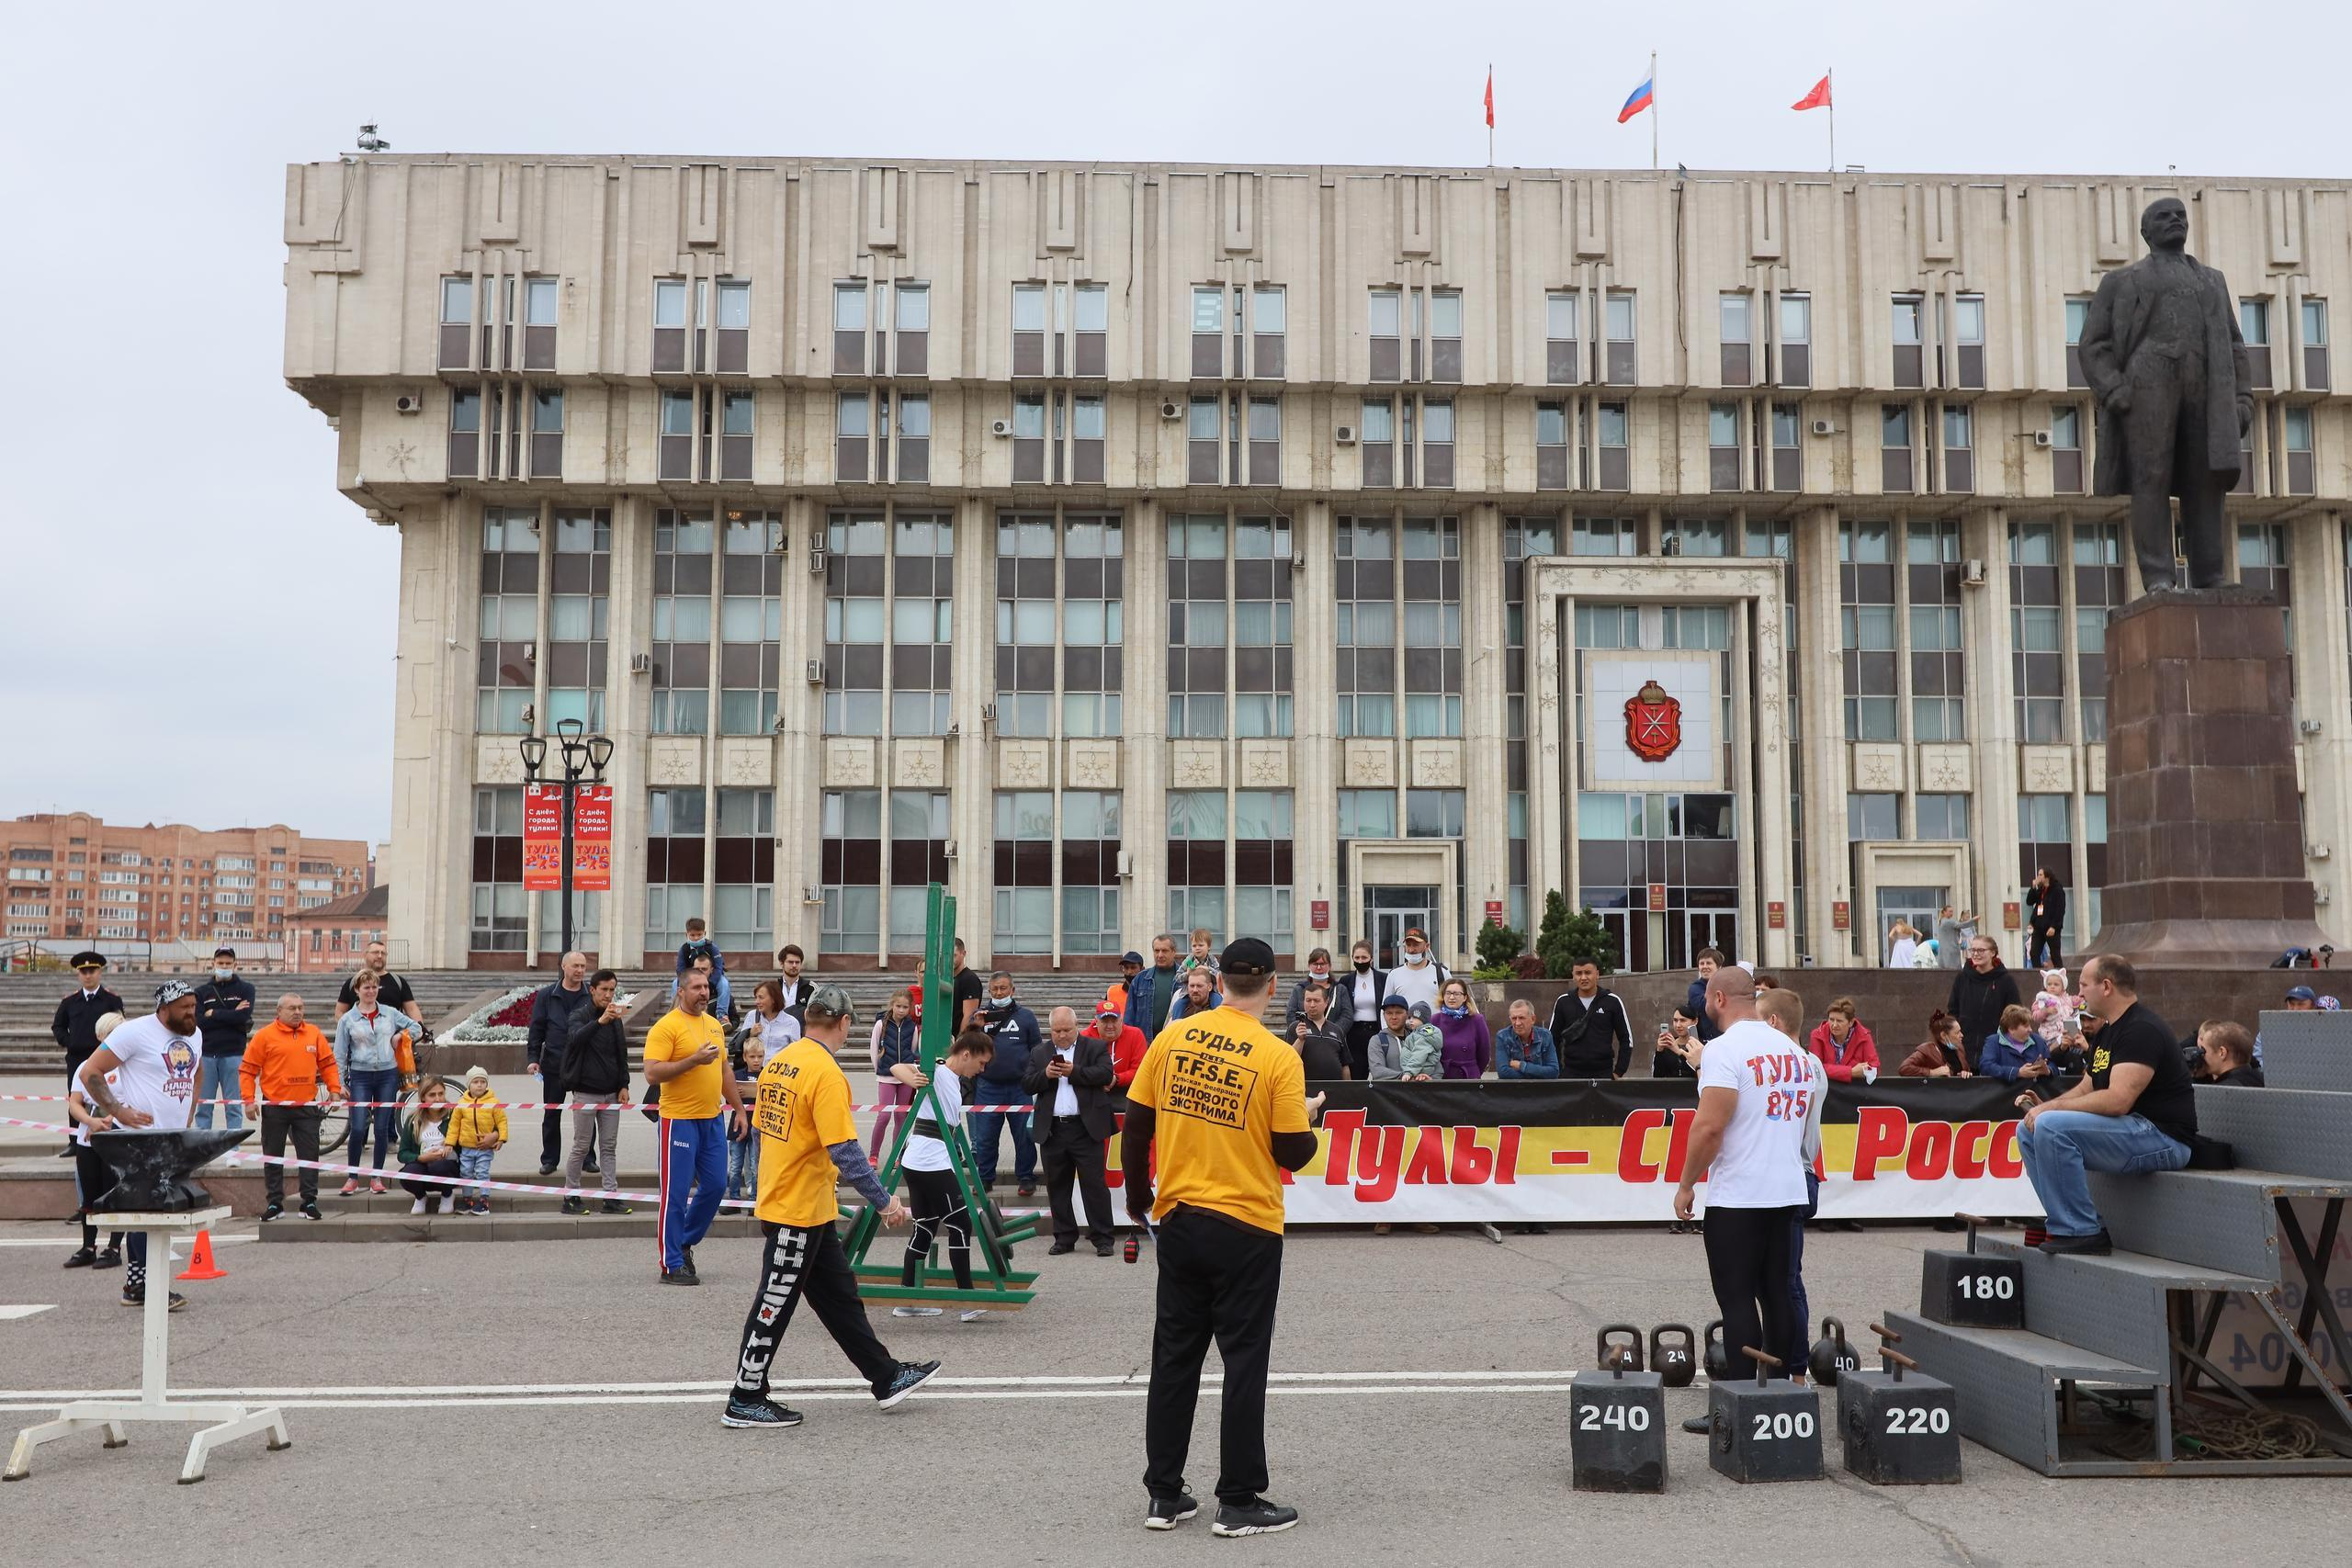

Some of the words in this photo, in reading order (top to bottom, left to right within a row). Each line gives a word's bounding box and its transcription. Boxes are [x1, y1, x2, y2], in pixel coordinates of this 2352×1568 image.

[1185, 1028, 1253, 1057] СУДЬЯ
[1175, 1055, 1243, 1090] T.F.S.E.
[1170, 1084, 1238, 1111] СИЛОВОГО
[1171, 1075, 1201, 1087] Тульская
[1203, 1083, 1241, 1099] федерация
[1170, 1096, 1237, 1122] ЭКСТРИМА
[1766, 1088, 1807, 1121] 875
[673, 1140, 689, 1148] RUSSIA
[193, 1252, 202, 1264] 8
[1957, 1275, 2014, 1300] 180
[736, 1329, 773, 1391] GET
[1667, 1349, 1687, 1363] 24
[1835, 1356, 1854, 1371] 40
[1578, 1404, 1650, 1432] 240
[1752, 1412, 1815, 1440] 200
[1885, 1407, 1951, 1434] 220
